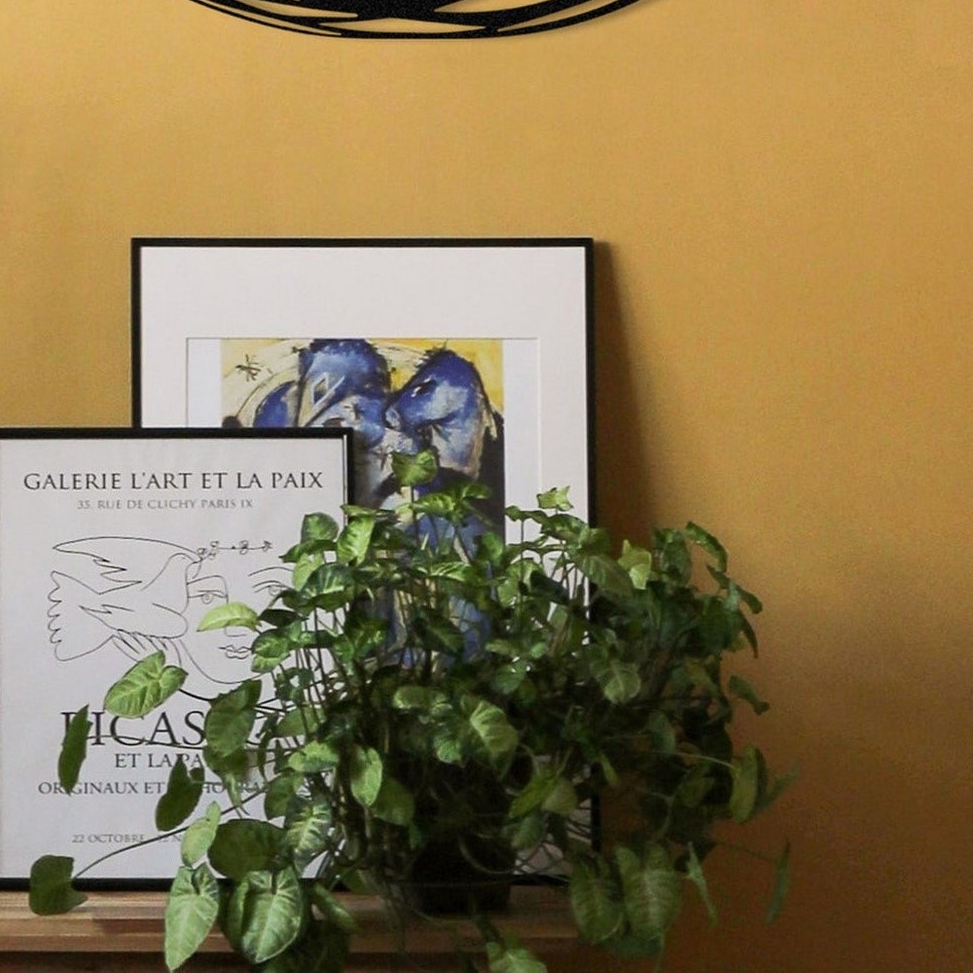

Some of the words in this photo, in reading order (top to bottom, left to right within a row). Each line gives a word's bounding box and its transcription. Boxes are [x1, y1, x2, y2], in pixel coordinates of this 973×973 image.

[23, 472, 121, 490] GALERIE
[131, 471, 193, 489] L'ART
[201, 472, 228, 489] ET
[236, 472, 263, 488] LA
[271, 471, 323, 488] PAIX
[97, 499, 121, 509] RUE
[127, 499, 143, 509] DE
[147, 499, 196, 508] CLICHY
[201, 498, 237, 508] PARIS
[241, 498, 254, 507] IX
[114, 753, 141, 768] ET
[147, 753, 173, 768] LA
[144, 781, 166, 795] ET
